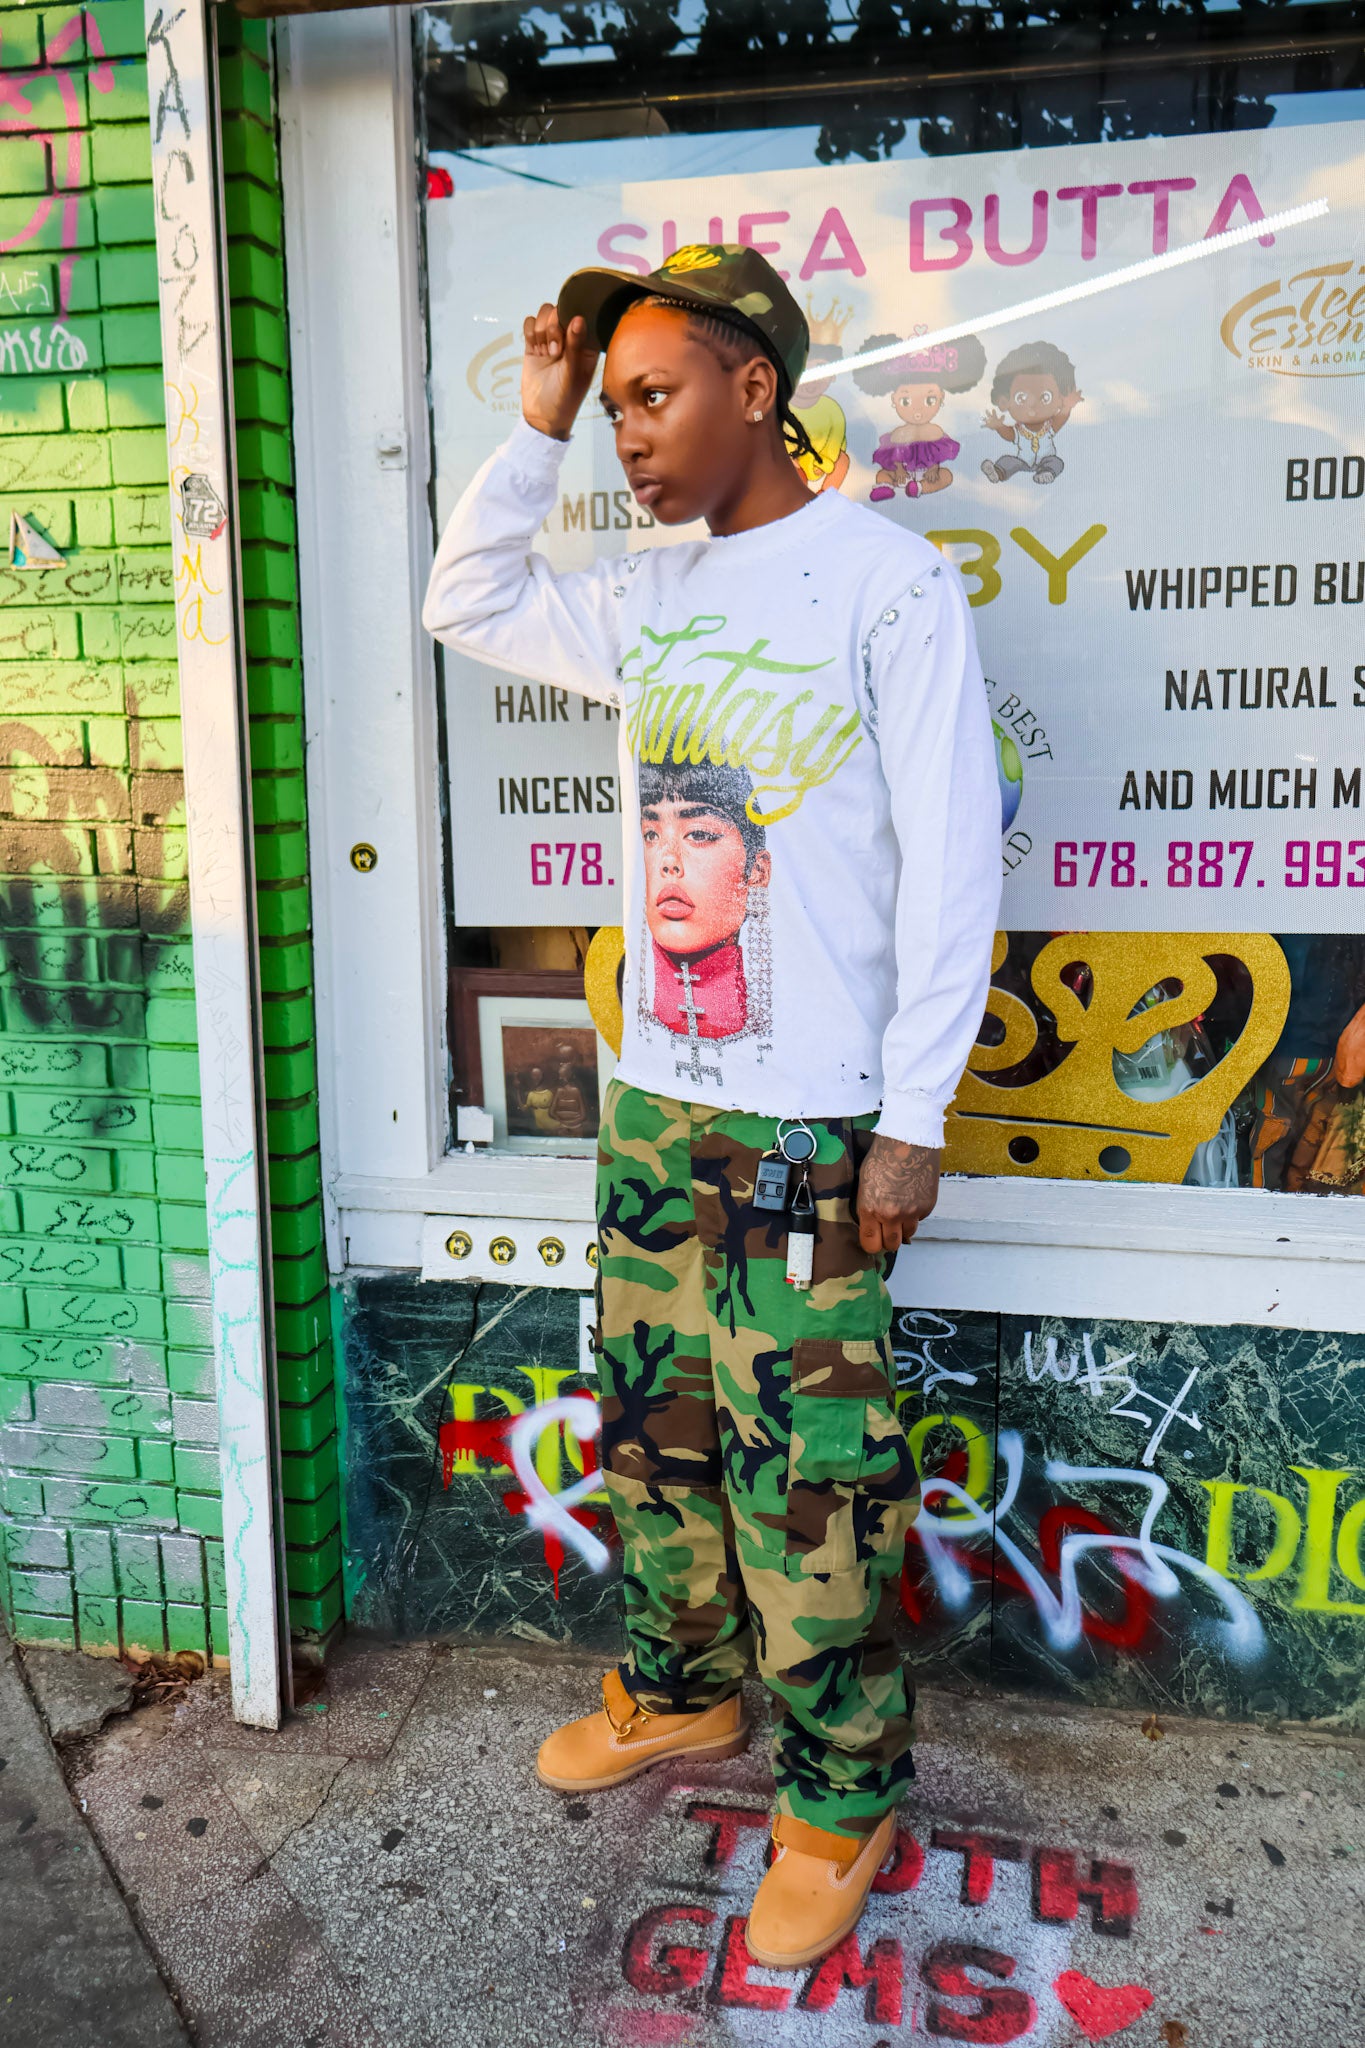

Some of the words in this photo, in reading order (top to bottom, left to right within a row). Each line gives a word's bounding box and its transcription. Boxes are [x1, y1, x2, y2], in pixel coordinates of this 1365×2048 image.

[909, 173, 1276, 273] BUTTA
[1248, 355, 1283, 369] SKIN
[1292, 354, 1301, 366] &
[1286, 456, 1365, 502] BOD
[190, 499, 219, 523] 72
[1125, 564, 1298, 611] WHIPPED
[1314, 561, 1365, 605] BU
[495, 684, 570, 723] HAIR
[1164, 666, 1337, 711] NATURAL
[622, 615, 863, 826] Fantasy
[997, 692, 1053, 762] BEST
[499, 776, 622, 815] INCENS
[1119, 770, 1194, 811] AND
[1209, 769, 1317, 810] MUCH
[531, 842, 615, 887] 678.
[1054, 841, 1148, 888] 678.
[1167, 841, 1266, 888] 887.
[686, 1801, 1140, 1939] TOTH
[620, 1902, 1038, 2046] GEMS
